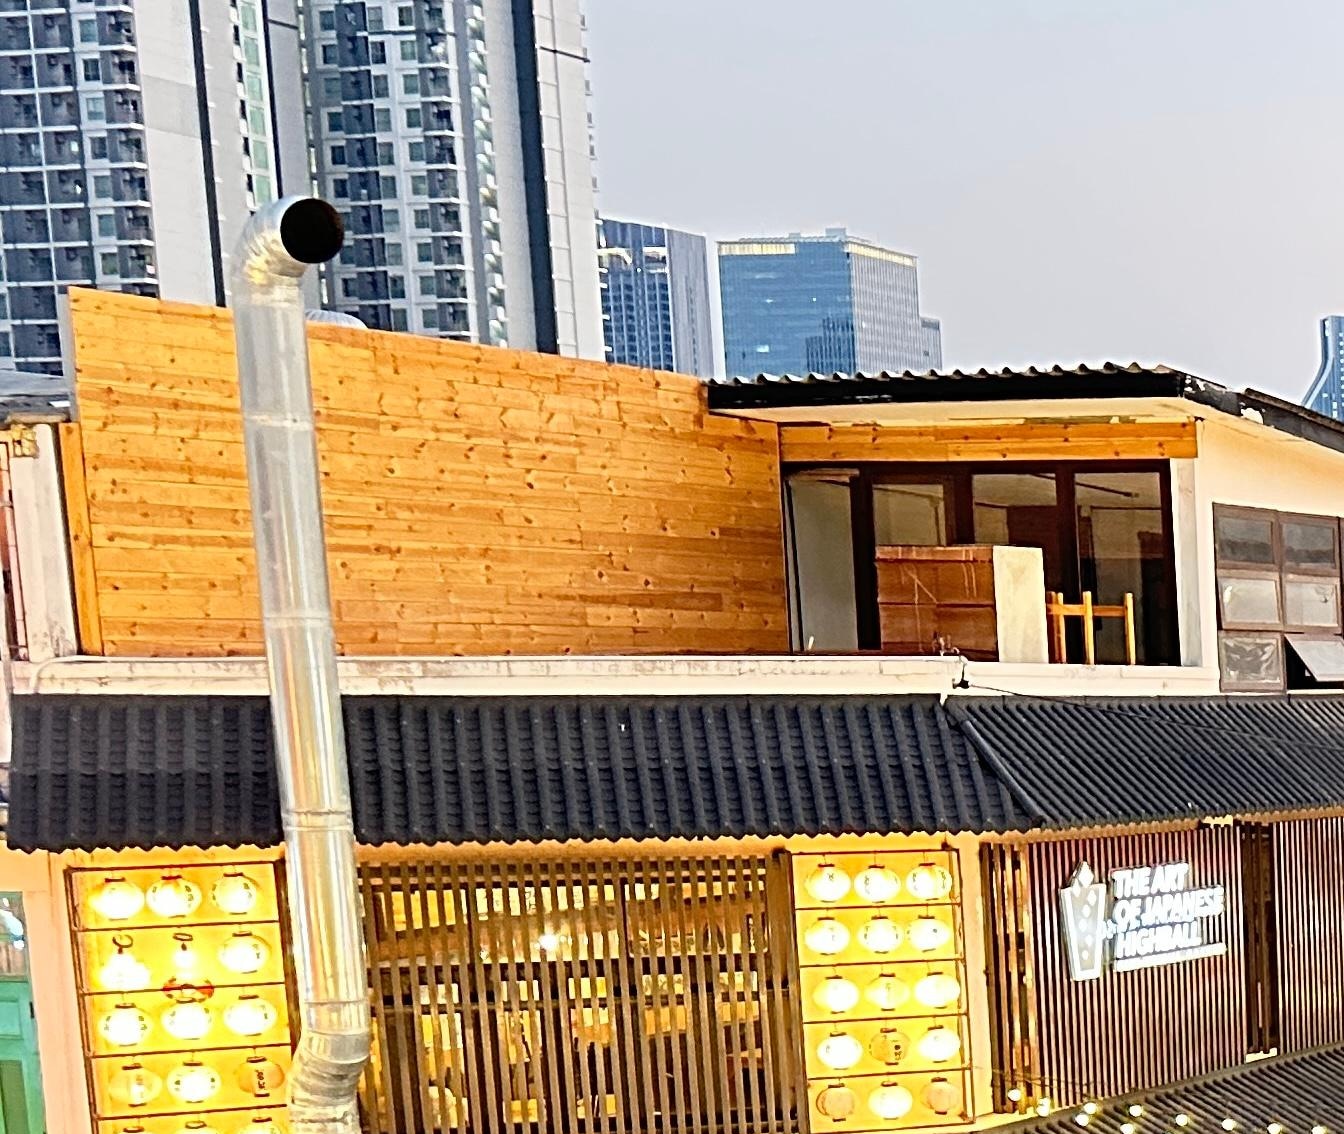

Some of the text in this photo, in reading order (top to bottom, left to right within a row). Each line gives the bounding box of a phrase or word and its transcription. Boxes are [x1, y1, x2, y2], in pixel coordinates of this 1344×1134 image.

[1112, 861, 1189, 898] THE ART
[1114, 885, 1224, 930] OF JAPANESE
[1116, 920, 1202, 959] HIGHBALL
